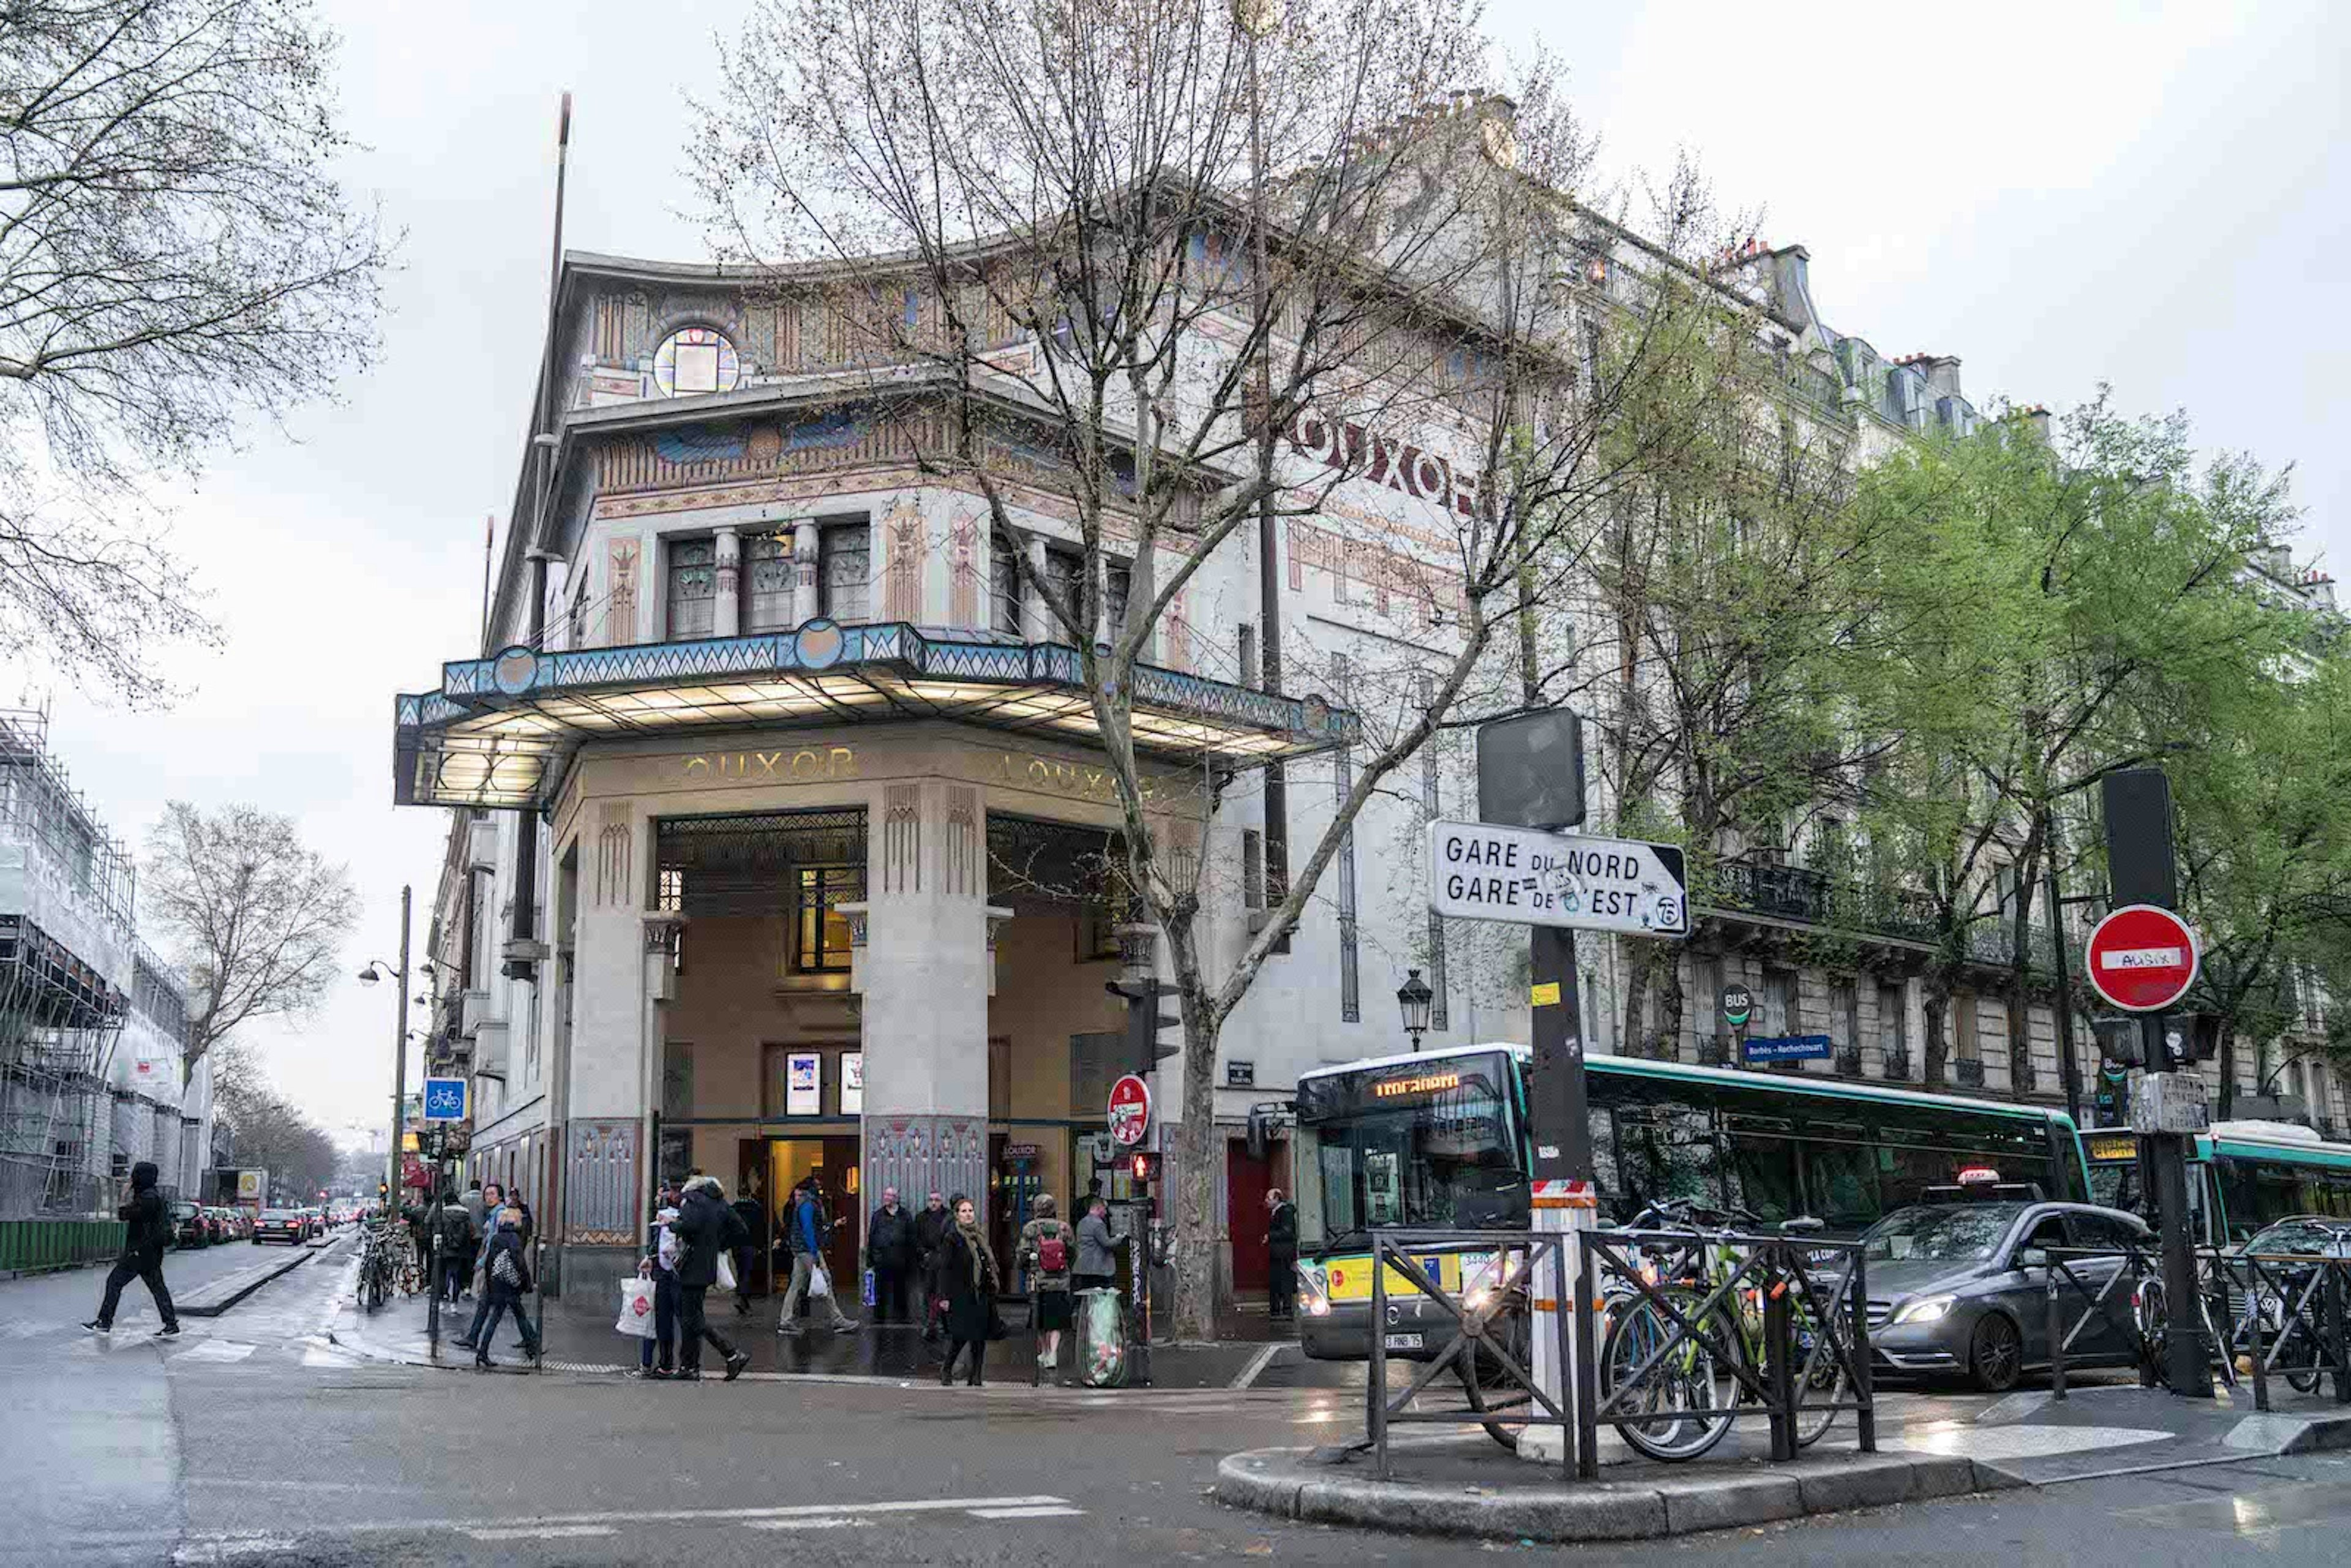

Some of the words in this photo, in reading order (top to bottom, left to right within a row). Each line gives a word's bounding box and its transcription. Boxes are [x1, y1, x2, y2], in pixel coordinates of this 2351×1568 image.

[1446, 837, 1518, 868] GARE
[1531, 855, 1554, 872] DU
[1568, 850, 1639, 880] NORD
[1447, 875, 1520, 906] GARE
[1533, 891, 1554, 909] DE
[1582, 888, 1638, 916] 'EST
[1725, 993, 1749, 1008] BUS
